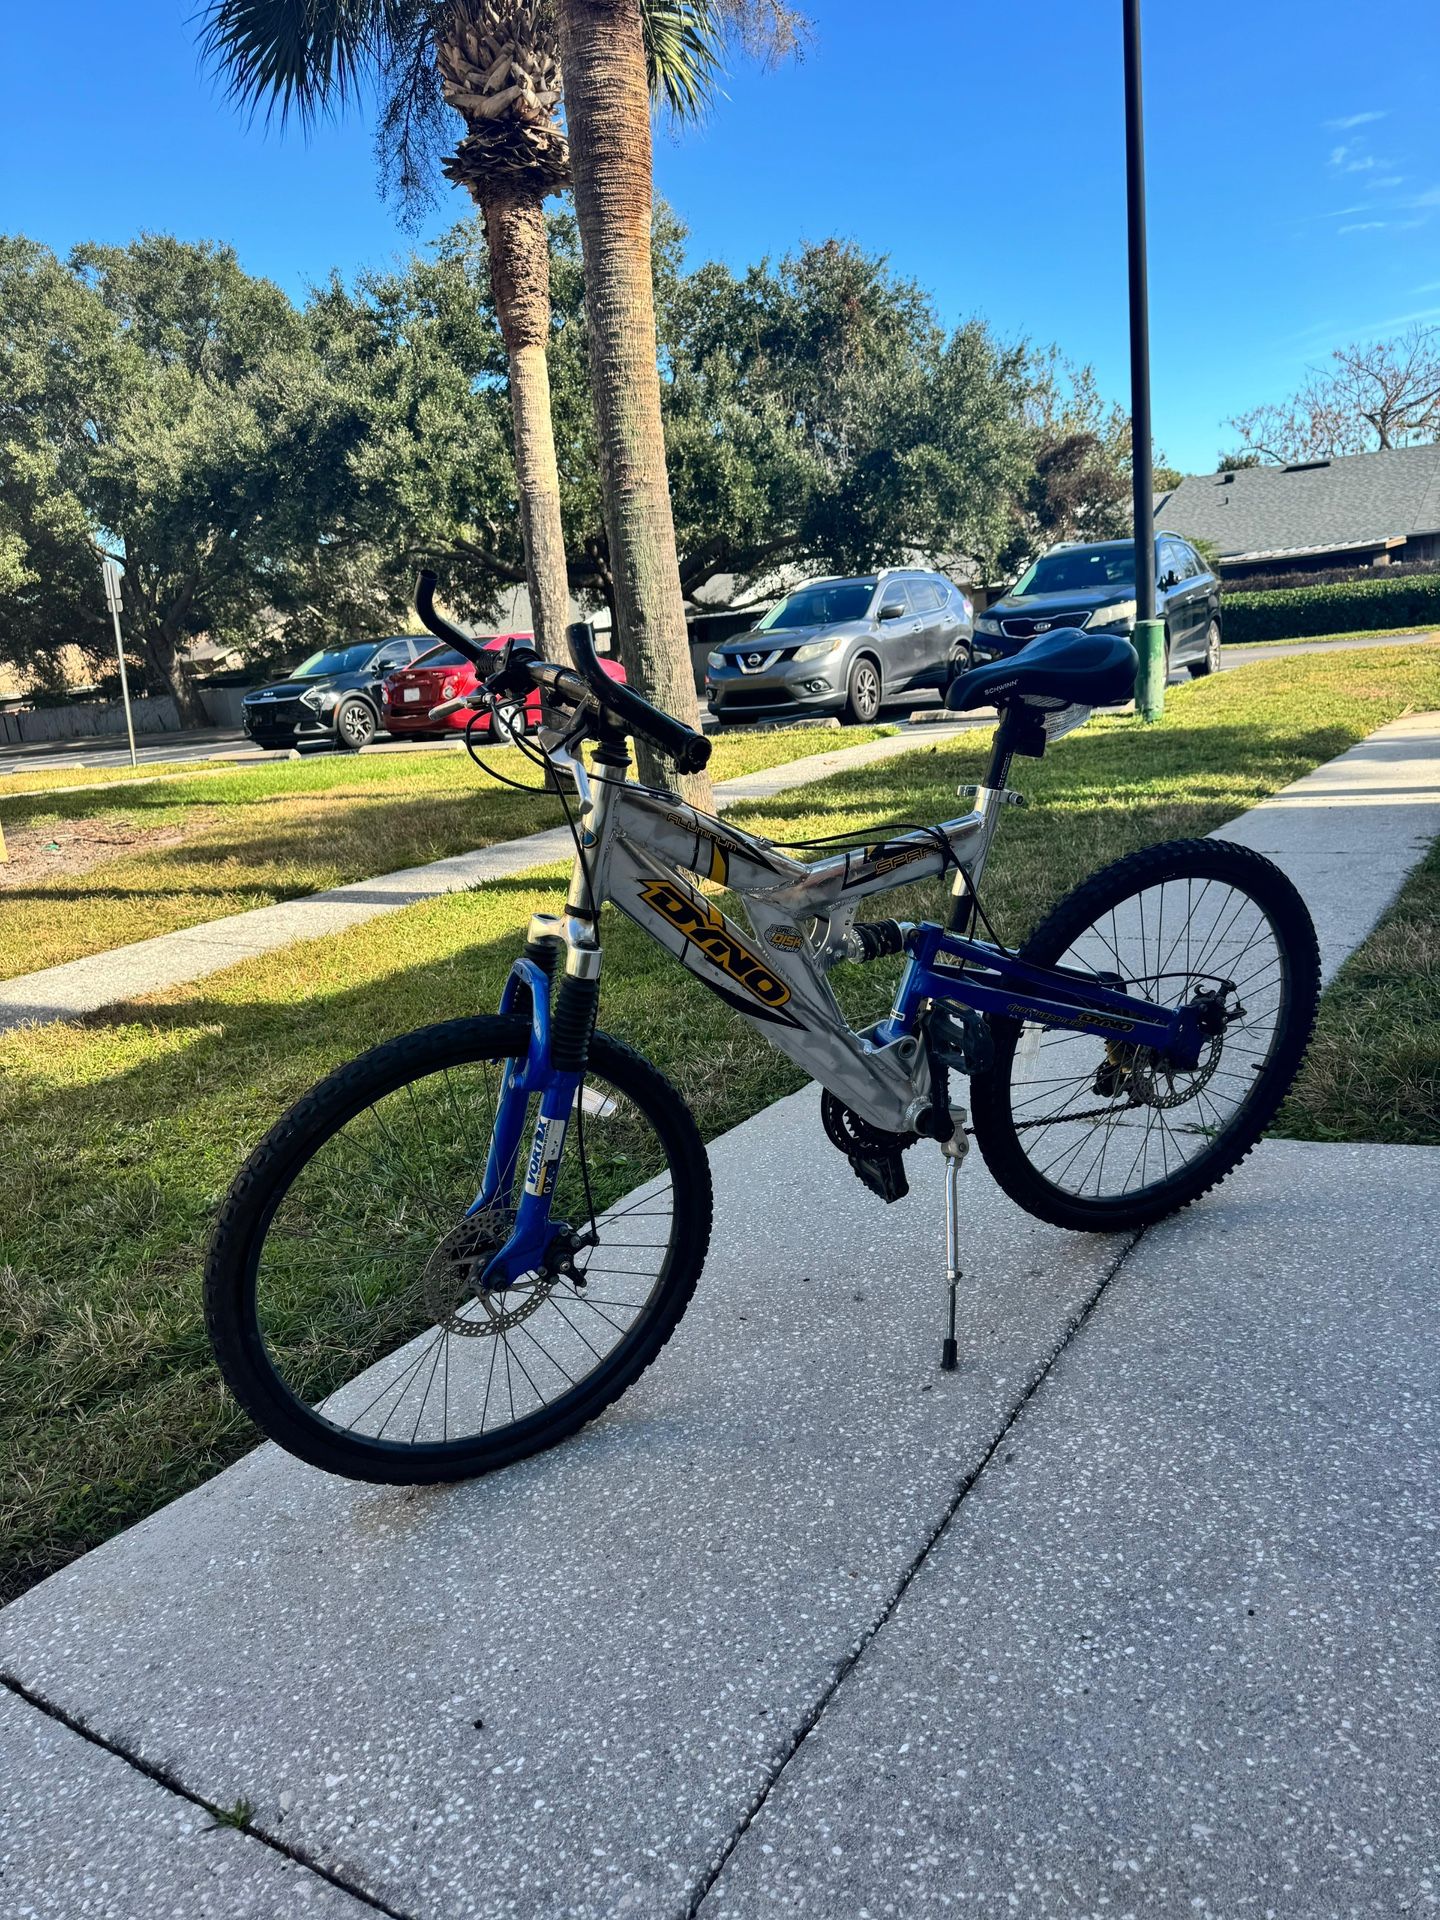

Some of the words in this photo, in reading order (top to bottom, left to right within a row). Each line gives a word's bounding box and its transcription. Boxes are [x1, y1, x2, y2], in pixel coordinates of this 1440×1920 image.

[984, 680, 1018, 695] SCHWINN
[667, 813, 737, 851] ALUMINUM
[638, 880, 791, 1007] DYNO
[527, 1122, 546, 1185] VORTX
